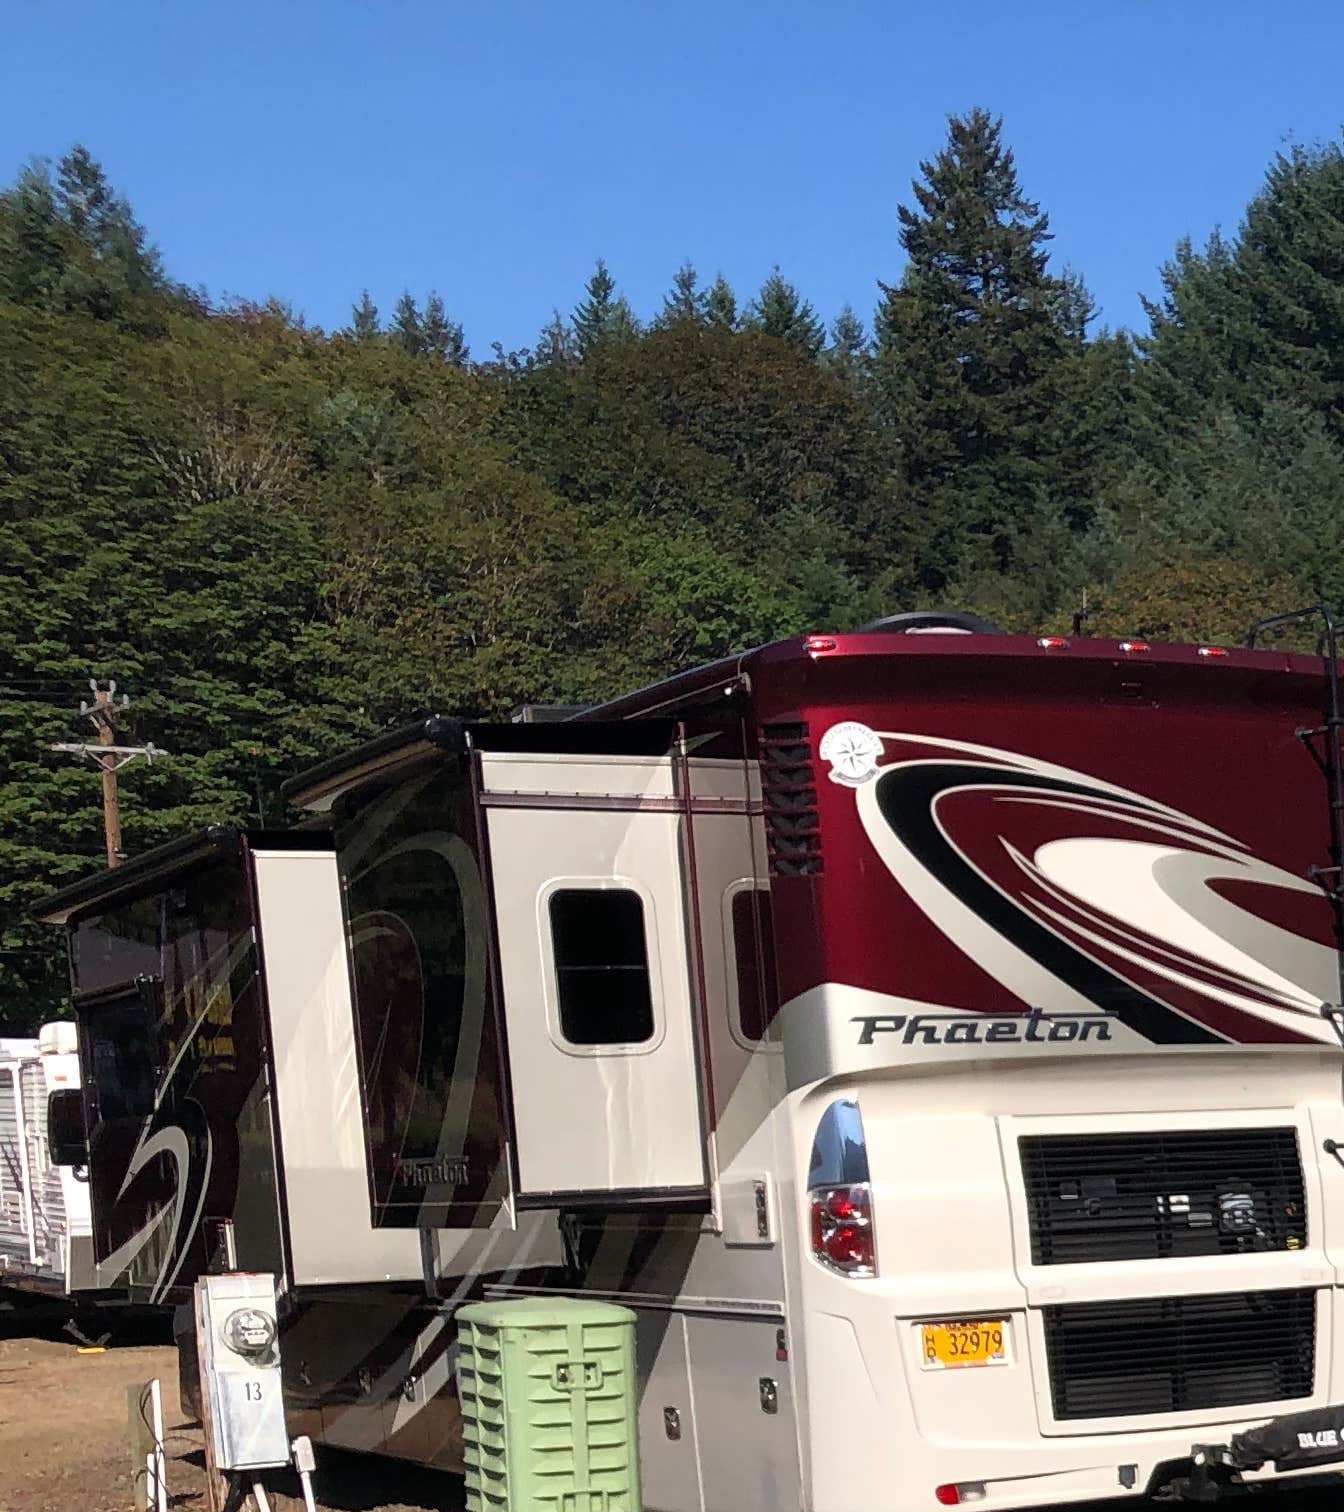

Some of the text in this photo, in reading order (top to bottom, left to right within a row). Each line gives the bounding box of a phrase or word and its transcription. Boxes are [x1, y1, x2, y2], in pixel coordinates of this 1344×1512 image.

[850, 1007, 1119, 1045] Phaeton
[948, 1329, 1003, 1356] 32979
[245, 1382, 262, 1401] 13
[1297, 1430, 1338, 1449] BLUE
